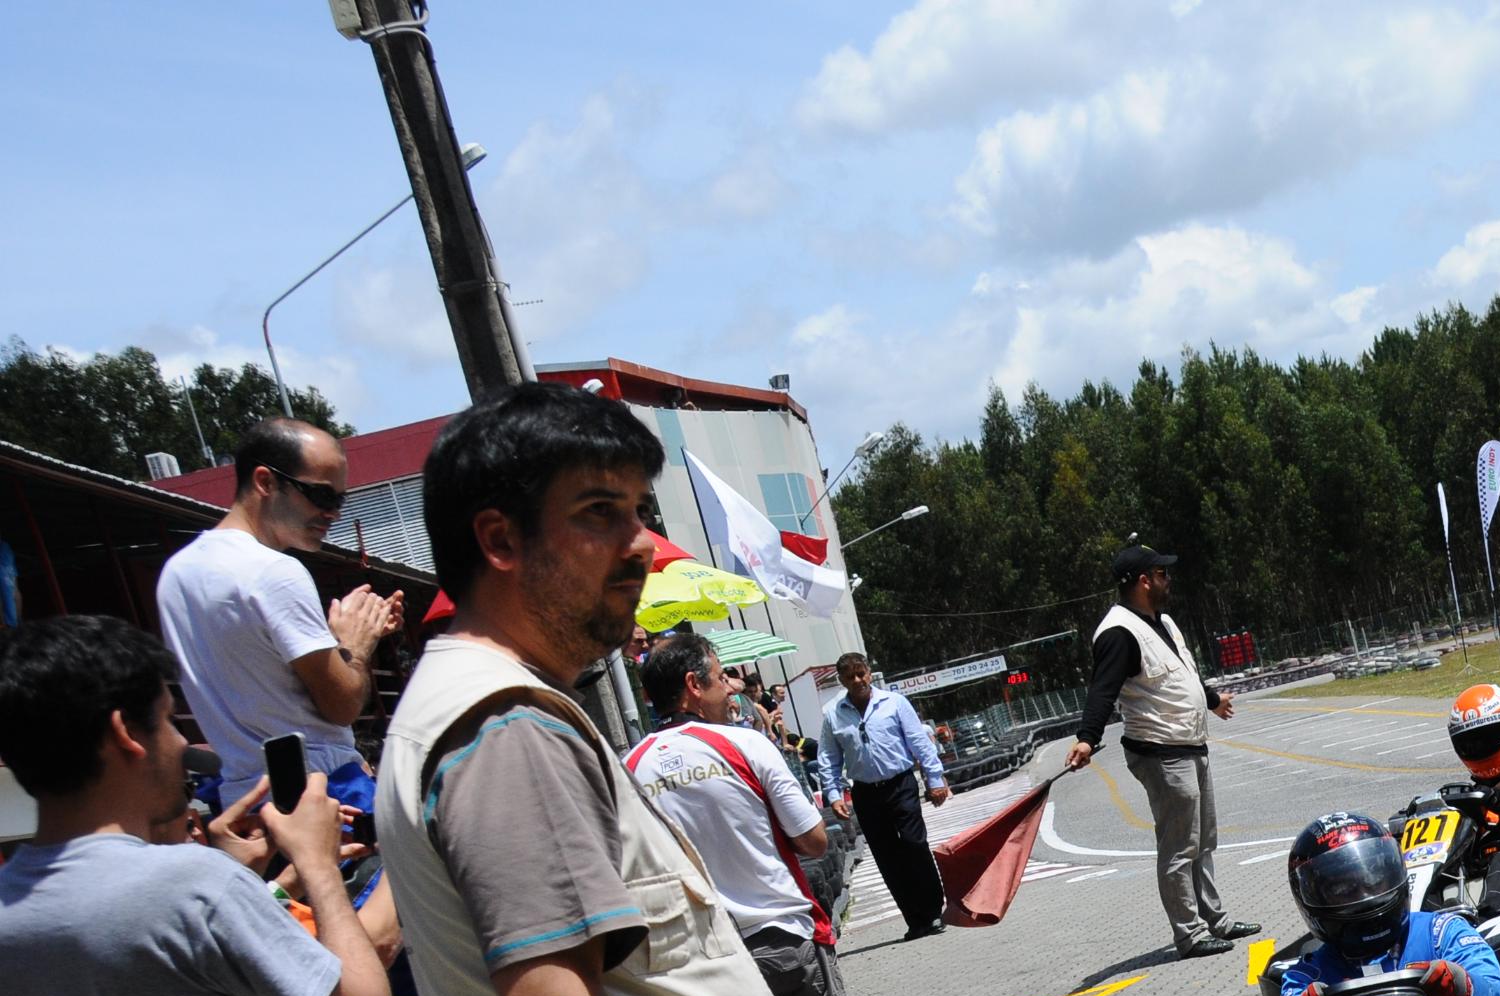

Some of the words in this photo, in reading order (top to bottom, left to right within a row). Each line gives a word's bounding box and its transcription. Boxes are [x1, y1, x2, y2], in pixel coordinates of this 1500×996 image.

[1488, 447, 1497, 467] INDY
[1488, 467, 1497, 492] EURO
[952, 668, 966, 677] 707
[968, 664, 978, 673] 20
[979, 661, 989, 670] 24
[990, 659, 1000, 667] 25
[643, 763, 730, 798] ORTUGAL
[1404, 814, 1449, 851] 127
